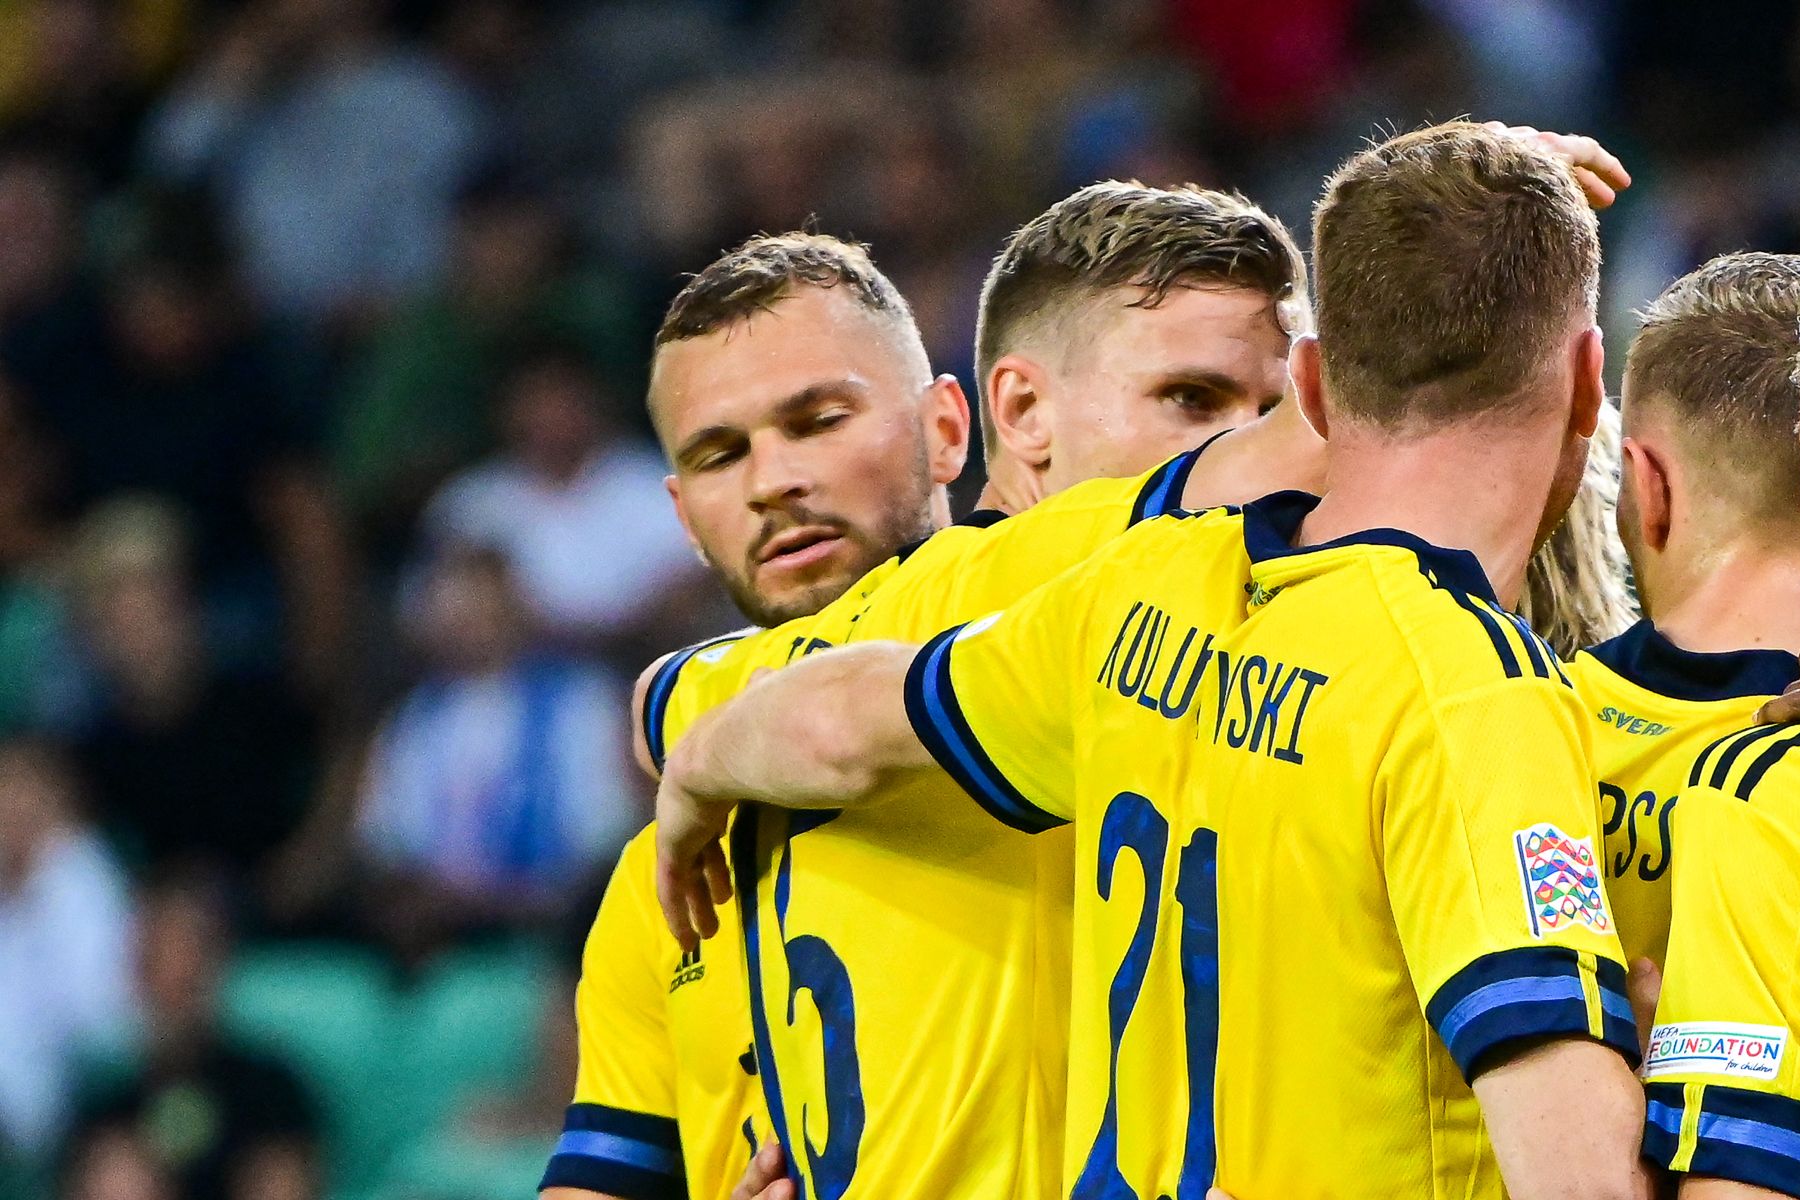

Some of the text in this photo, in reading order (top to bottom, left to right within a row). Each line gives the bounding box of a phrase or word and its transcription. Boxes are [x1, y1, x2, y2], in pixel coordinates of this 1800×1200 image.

[1096, 600, 1330, 766] KULUVSKI
[1653, 1026, 1679, 1039] UEFA
[1649, 1037, 1780, 1060] FOUNDATION
[1725, 1058, 1773, 1073] for children
